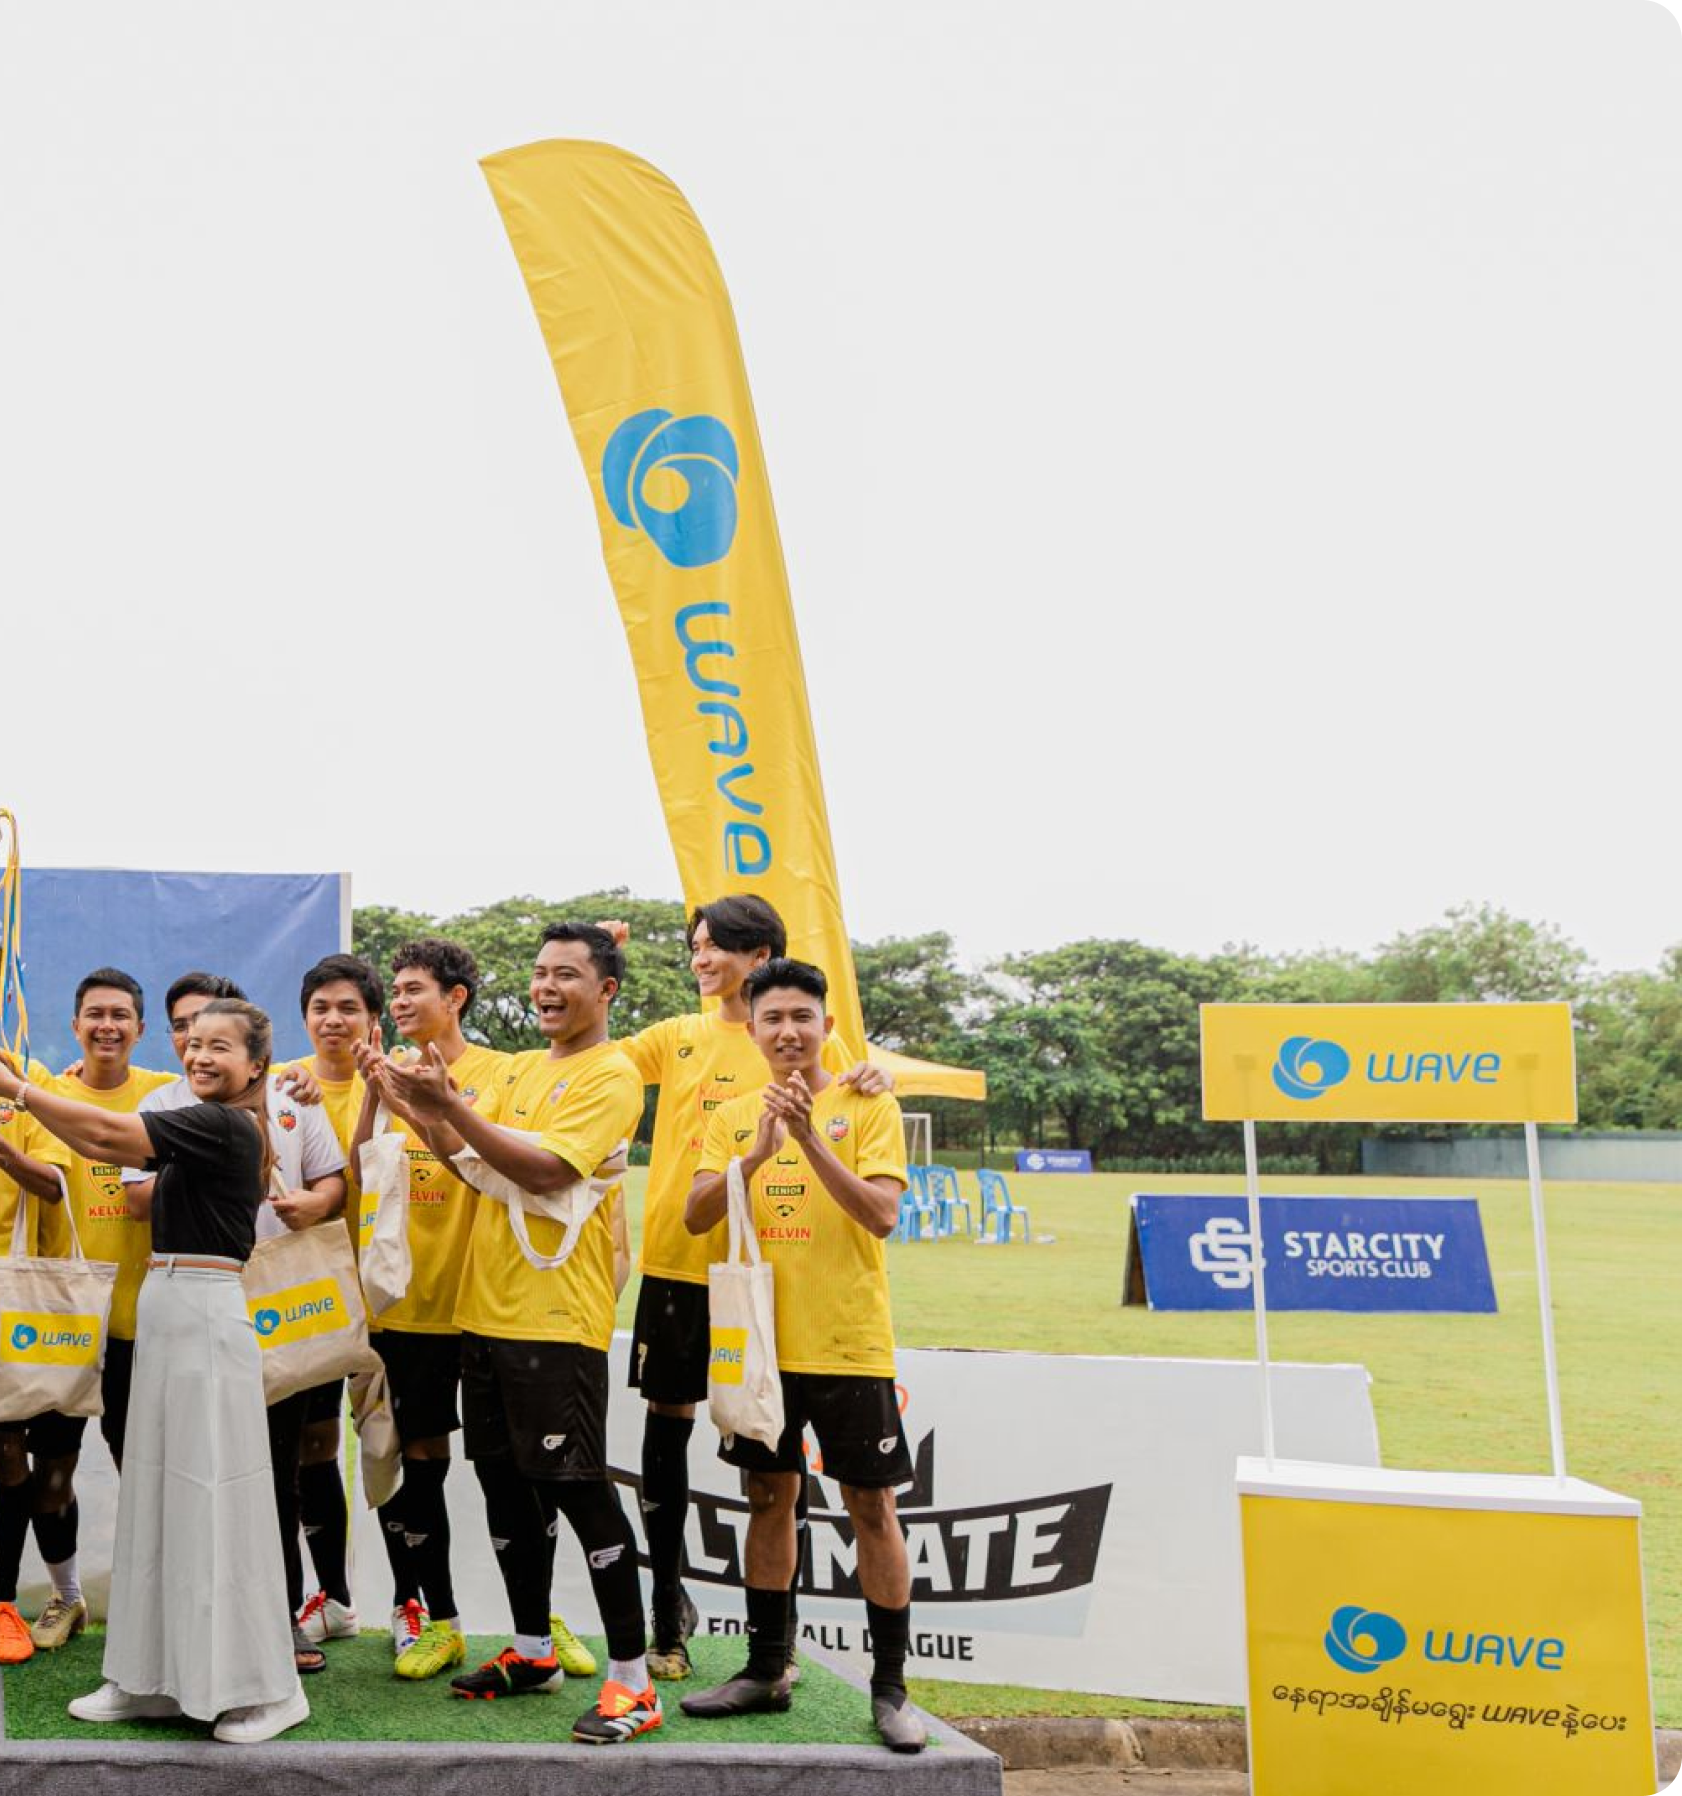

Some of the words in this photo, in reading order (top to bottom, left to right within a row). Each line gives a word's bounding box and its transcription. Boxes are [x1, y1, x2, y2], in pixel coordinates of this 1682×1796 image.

[759, 1226, 810, 1239] KELVIN
[1283, 1230, 1445, 1260] STARCITY
[1306, 1258, 1378, 1278] SPORTS
[1381, 1260, 1433, 1279] CLUB
